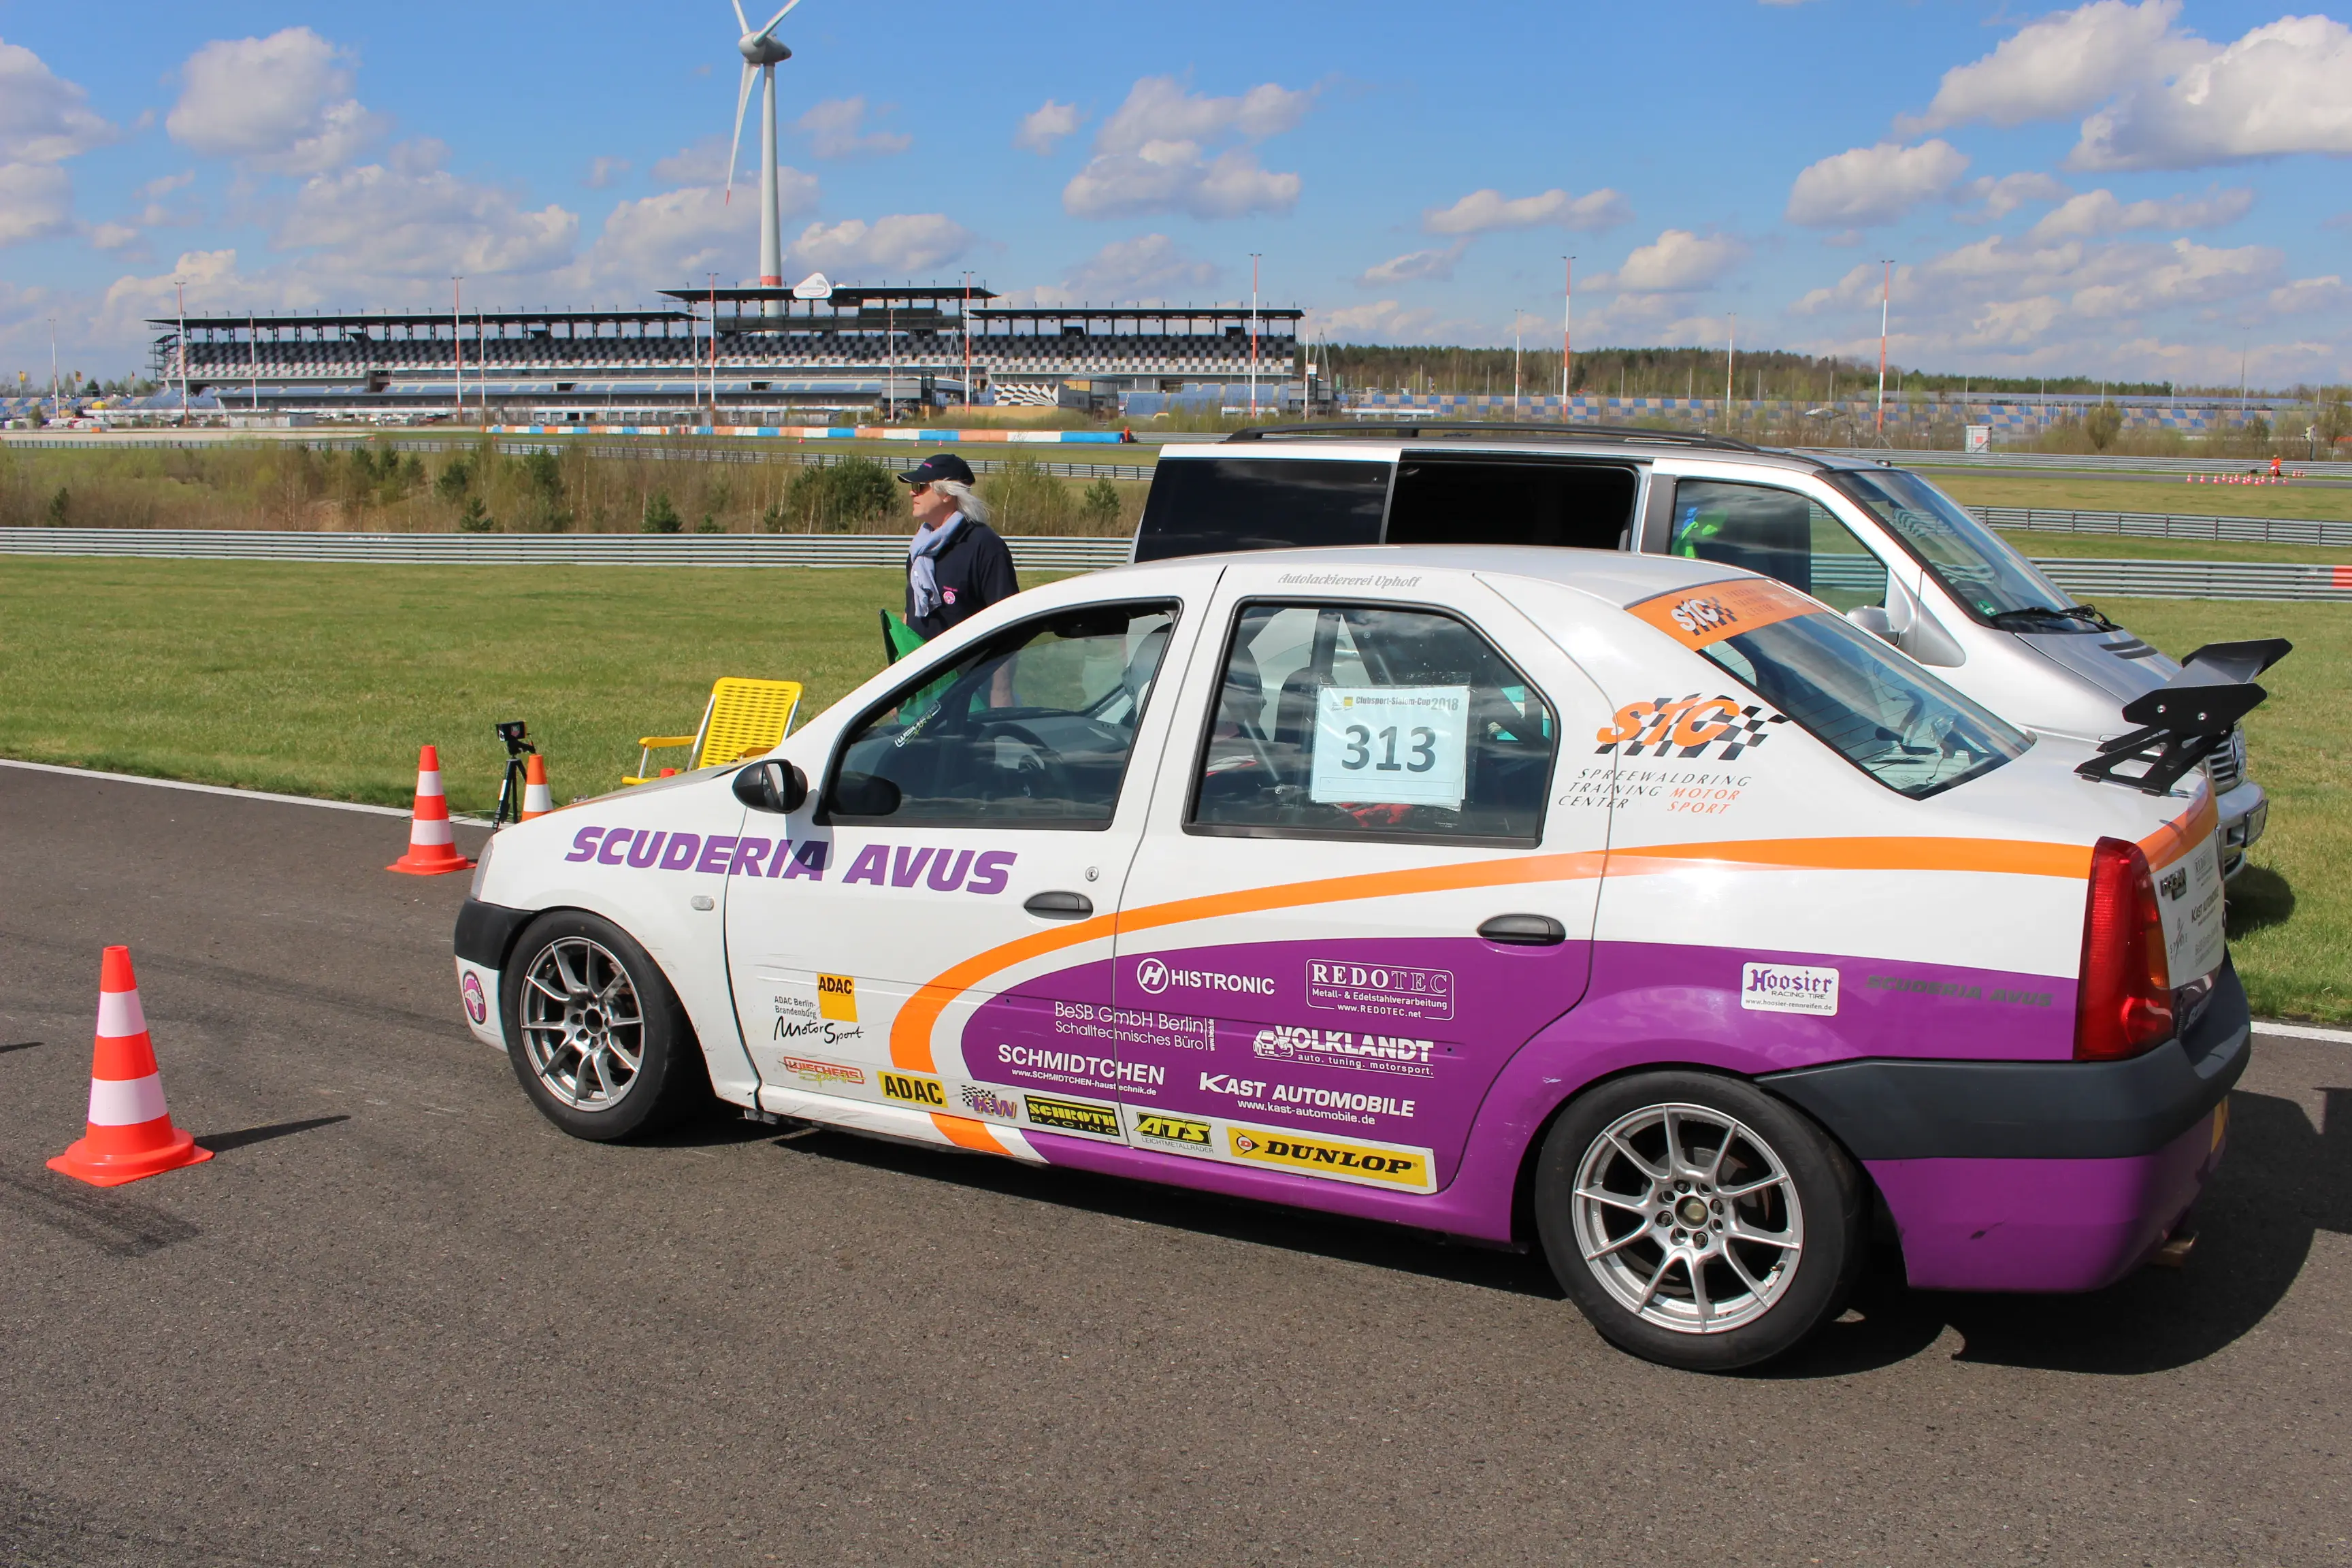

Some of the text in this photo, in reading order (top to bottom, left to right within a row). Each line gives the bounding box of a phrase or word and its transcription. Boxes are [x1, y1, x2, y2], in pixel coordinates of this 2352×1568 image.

[1278, 573, 1422, 589] Autolackiererei Uphoff
[1671, 600, 1719, 632] STC
[1431, 698, 1459, 710] 2018
[1596, 696, 1741, 747] STC
[1341, 724, 1436, 772] 313
[1578, 768, 1752, 787] SPREEWALDRING
[1568, 782, 1741, 801] TRAINING MOTOR
[1558, 796, 1731, 815] CENTER SPORT
[564, 826, 1017, 894] SCUDERIA AVUS
[819, 976, 852, 994] ADAC
[1171, 969, 1275, 995] HISTRONIC
[1311, 964, 1448, 994] REDOTEC
[1746, 968, 1832, 993] Hoosier
[1866, 975, 2053, 1007] SCUDERIA AVUS
[774, 996, 815, 1008] ADAC Berlin-
[1312, 987, 1342, 999] Metall-
[1353, 991, 1448, 1011] Edelstahlverarbeitung
[1337, 1003, 1422, 1019] www.REDOTEC.net
[1746, 999, 1832, 1010] www.hoosier-rennreifen.de
[775, 1005, 817, 1019] Brandenburg
[1055, 1001, 1203, 1034] BeSB GmbH Berlin
[1056, 1021, 1204, 1050] Schalltechnisches Büro
[1275, 1025, 1434, 1063] VOLKLANDT
[998, 1043, 1166, 1085] SCHMIDTCHEN
[1298, 1053, 1434, 1076] auto. tuning. motorsport.
[885, 1075, 943, 1105] ADAC
[1198, 1071, 1416, 1117] KAST AUTOMOBILE
[973, 1095, 1017, 1119] KW
[1028, 1102, 1117, 1127] SCHROTH
[1237, 1100, 1375, 1125] www.kast-automobile.de
[1031, 1116, 1118, 1134] RACING
[1132, 1115, 1211, 1142] ATS
[1264, 1139, 1413, 1174] DUNLOP
